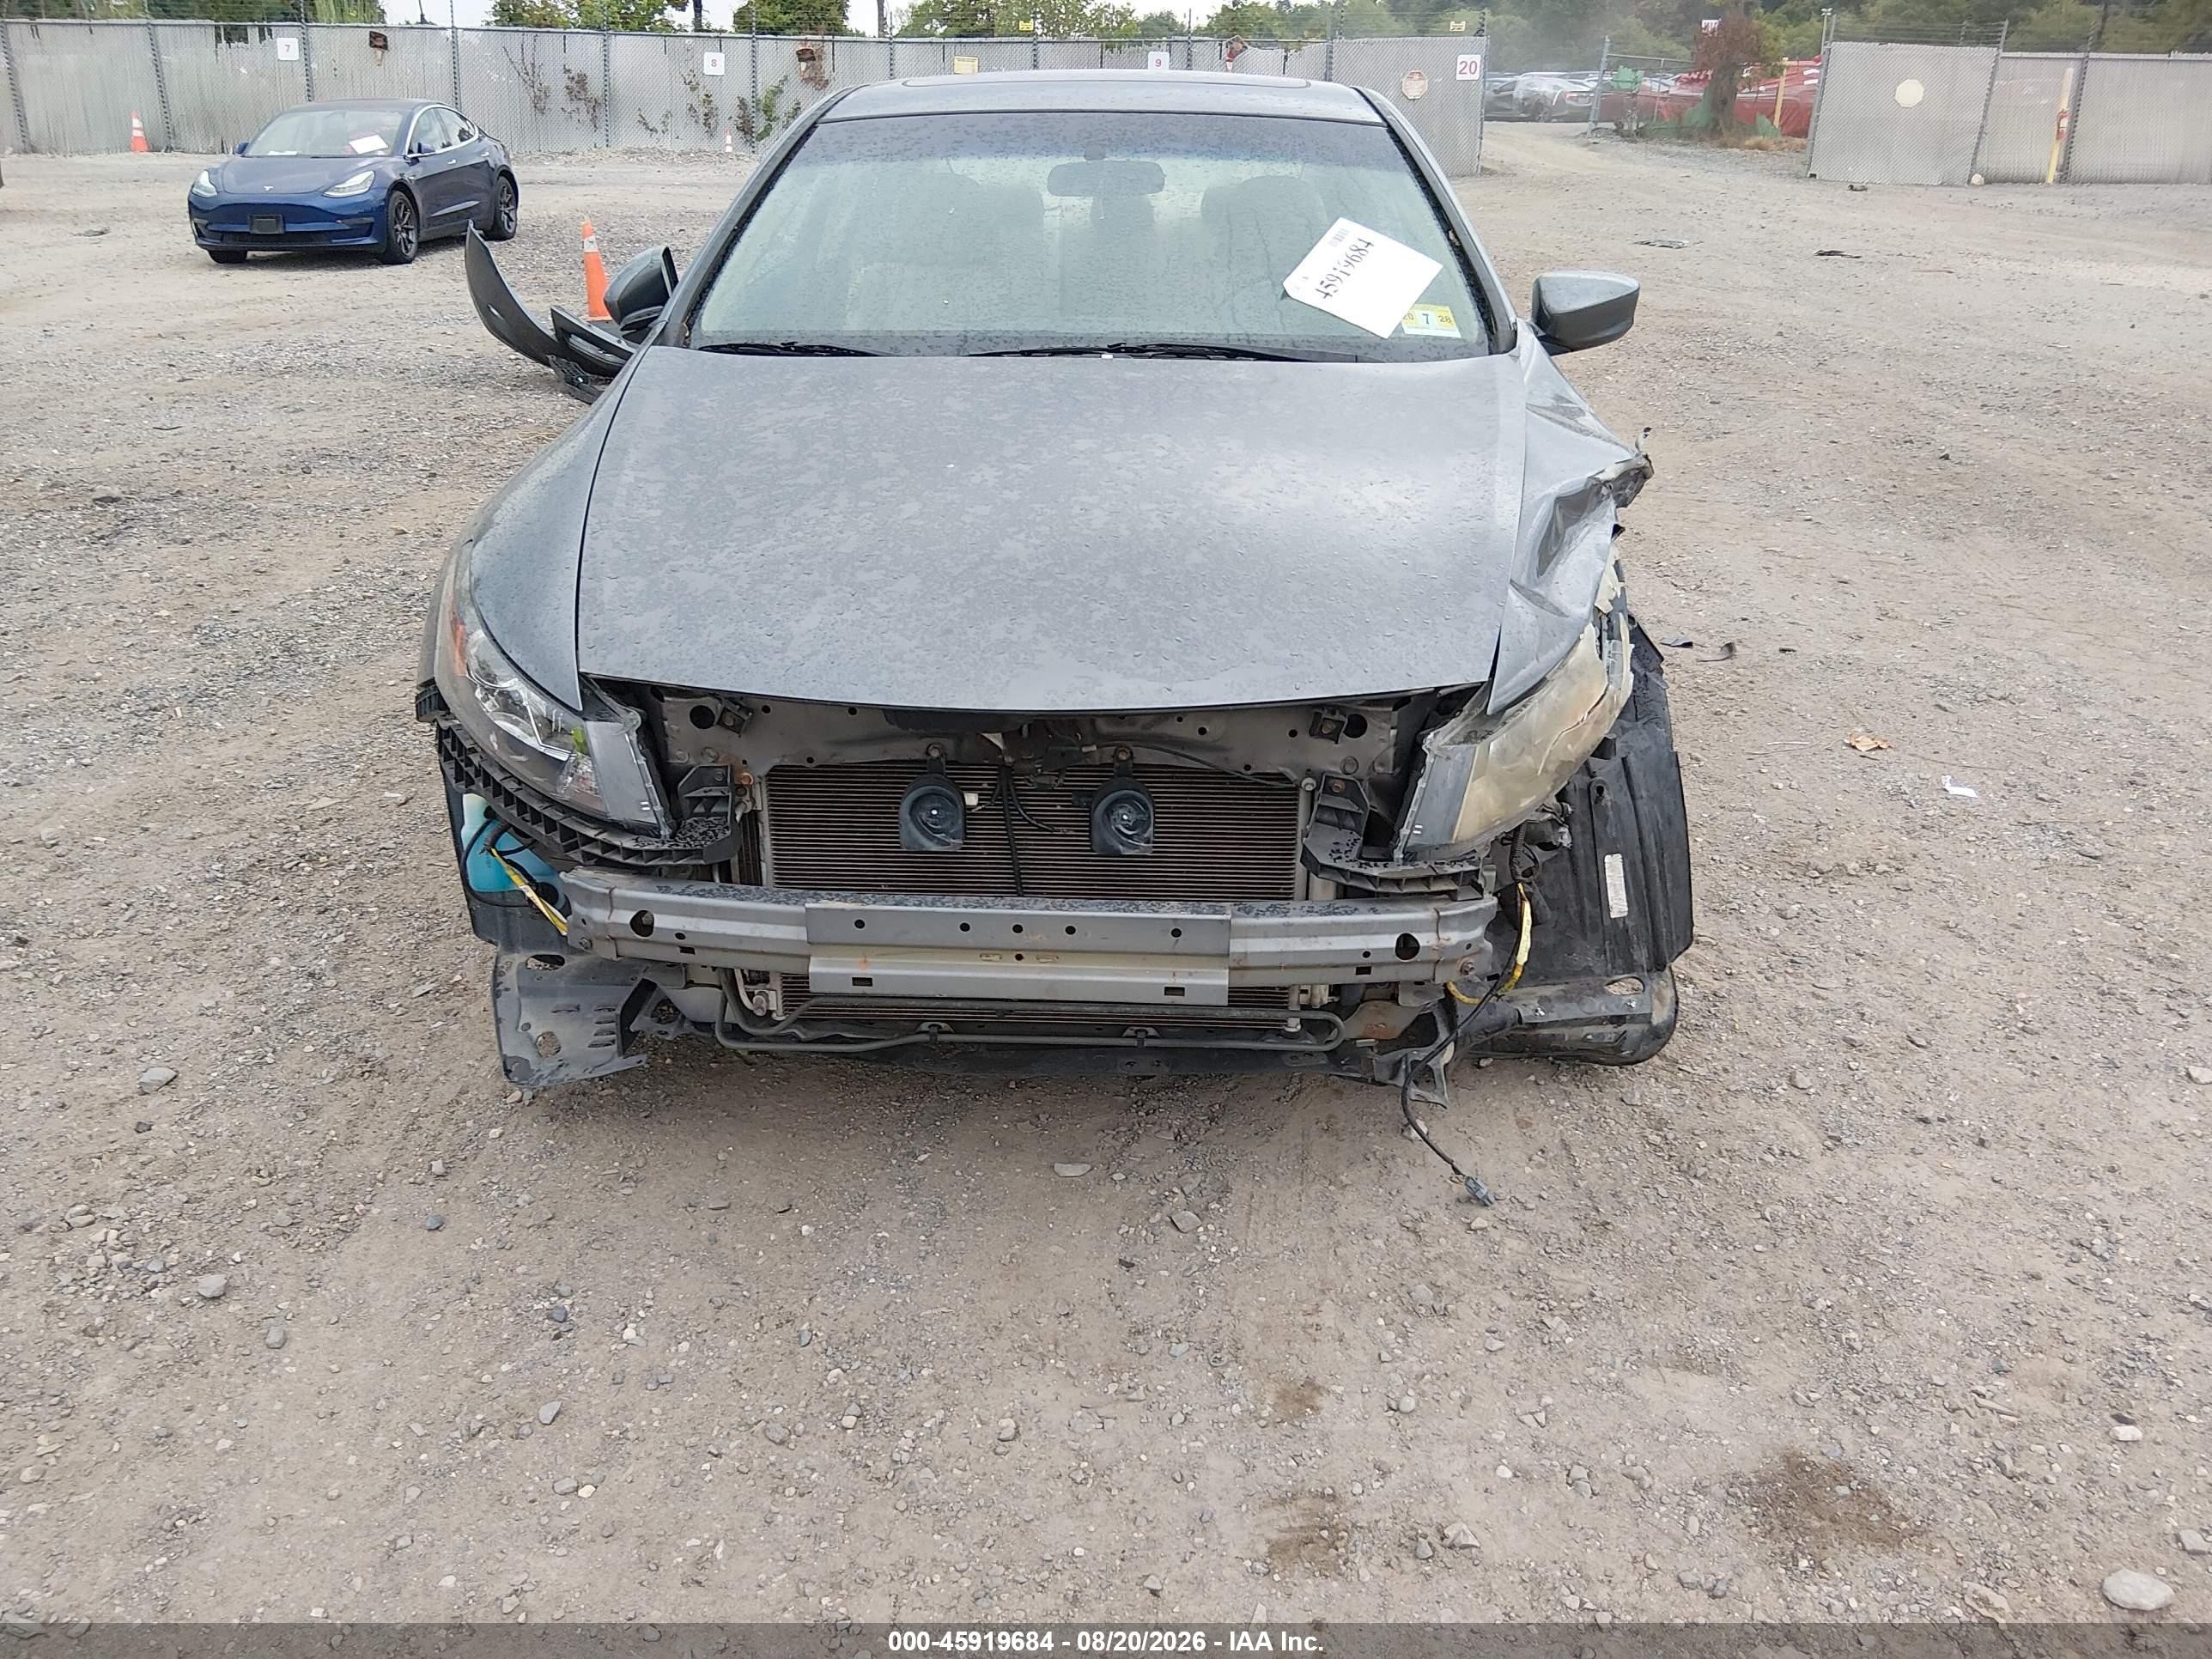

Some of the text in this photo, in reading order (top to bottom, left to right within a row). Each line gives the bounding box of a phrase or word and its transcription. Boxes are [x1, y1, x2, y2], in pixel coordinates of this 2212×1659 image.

[284, 44, 290, 52] 7
[711, 58, 718, 67] 8
[1155, 58, 1162, 67] 9
[1458, 60, 1478, 75] 20
[1315, 237, 1375, 300] 45919684
[1422, 313, 1430, 325] 7
[1437, 315, 1452, 324] 28
